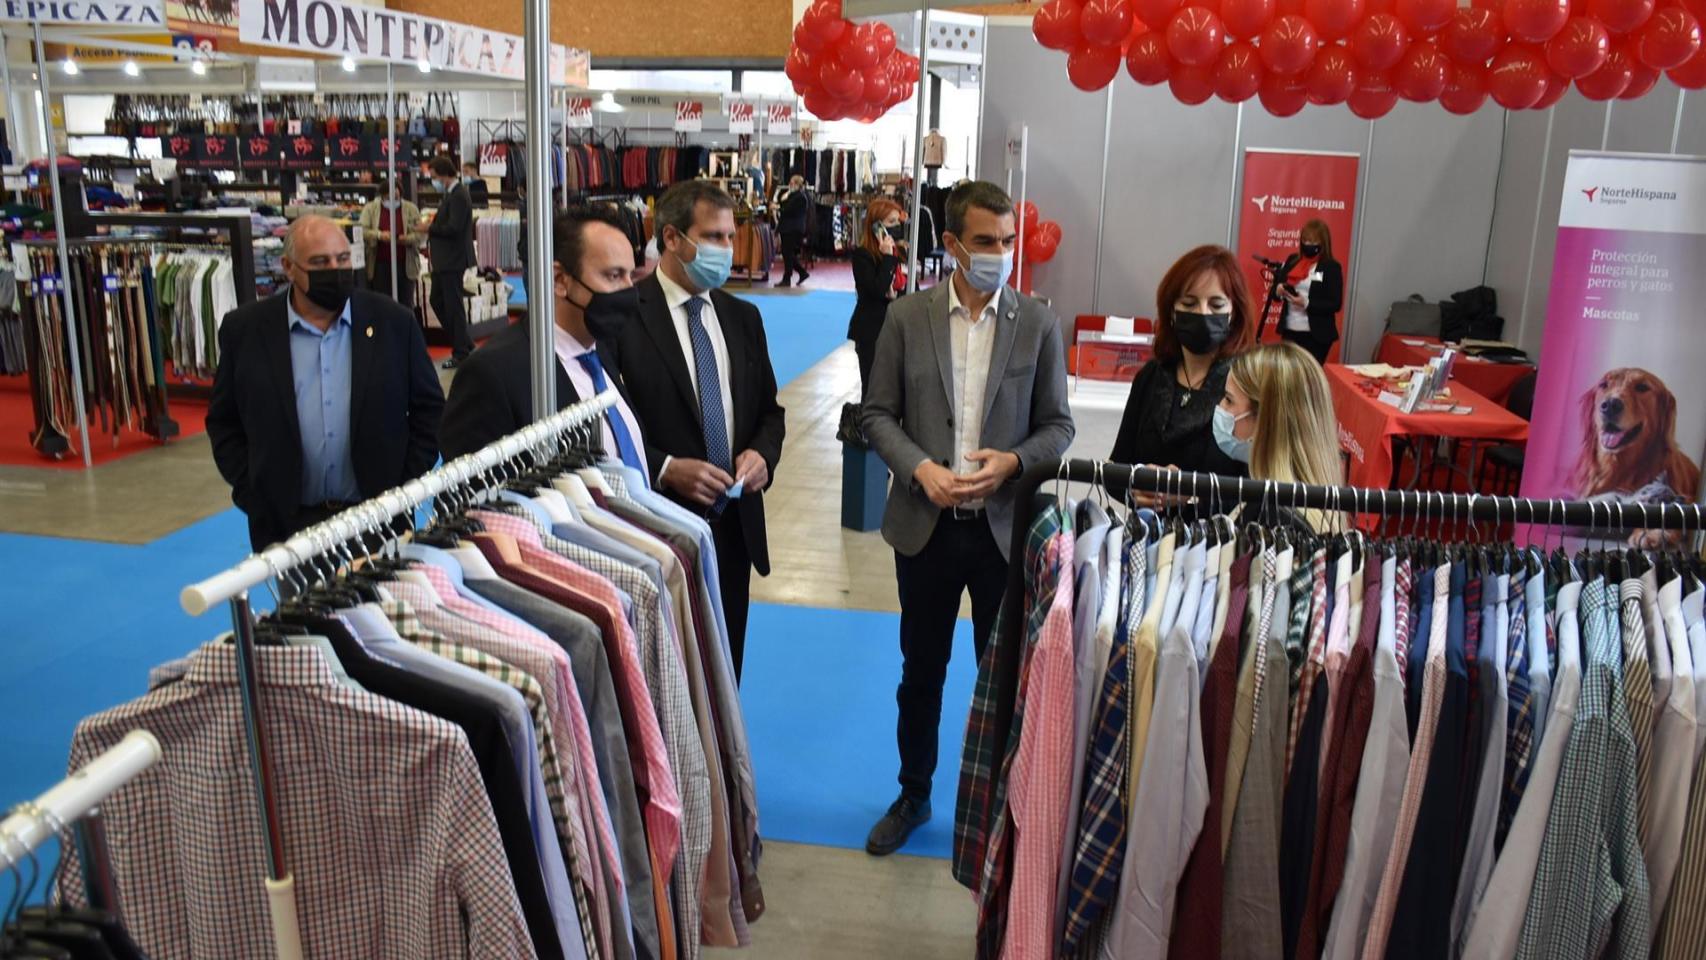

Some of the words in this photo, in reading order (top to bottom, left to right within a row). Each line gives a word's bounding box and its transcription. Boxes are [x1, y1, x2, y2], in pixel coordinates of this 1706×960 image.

[261, 0, 525, 74] MONTEPICAZ
[1601, 187, 1677, 201] NorteHispana
[1271, 195, 1345, 210] NorteHispana
[1267, 228, 1300, 240] Segurid
[1591, 249, 1657, 265] Protección
[1589, 262, 1638, 278] integral
[1640, 267, 1670, 279] para
[1587, 278, 1627, 289] perros
[1631, 281, 1639, 292] y
[1640, 281, 1673, 292] gatos
[1582, 307, 1640, 322] Mascotas
